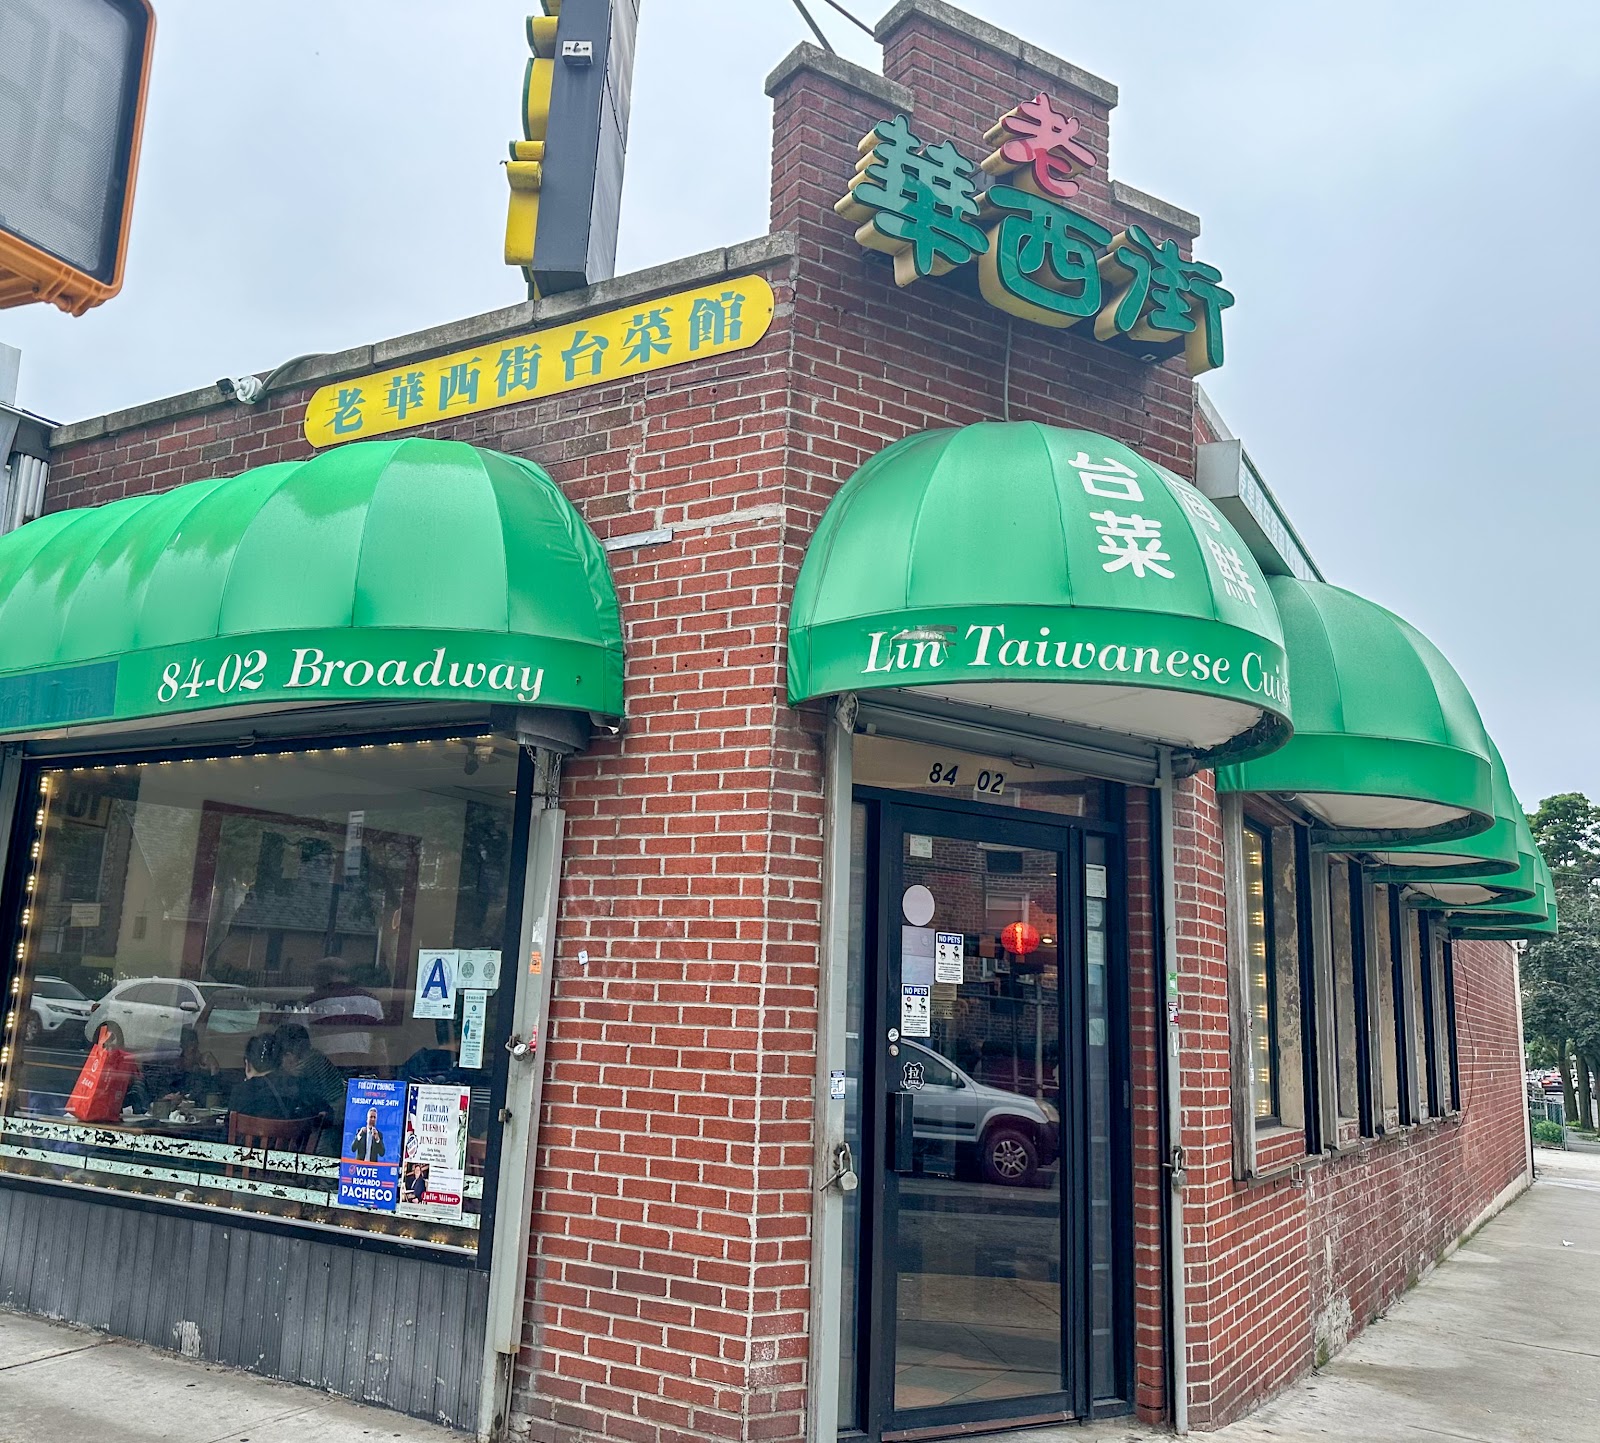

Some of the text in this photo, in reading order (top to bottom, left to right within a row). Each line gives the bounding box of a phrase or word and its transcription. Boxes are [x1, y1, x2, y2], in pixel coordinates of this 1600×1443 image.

[1001, 91, 1098, 198] 老
[846, 113, 1235, 369] 華西街
[323, 290, 747, 436] 老華西街台菜館
[1068, 451, 1176, 579] 台菜
[861, 630, 949, 675] Lin
[964, 623, 1231, 685] Taiwanese
[156, 647, 545, 704] 84-02 Broadway
[929, 762, 1005, 794] 84 02
[938, 934, 961, 944] NO PETS
[421, 958, 448, 999] A
[904, 986, 928, 995] NO PETS
[908, 1066, 920, 1079] 拉
[351, 1097, 372, 1105] TUESDAY
[385, 1099, 400, 1107] 24TH
[423, 1103, 449, 1114] PRIMARY
[422, 1113, 449, 1123] ELECTION
[419, 1136, 434, 1145] JUNE
[356, 1166, 378, 1178] VOTE
[352, 1177, 381, 1187] RICARDO
[341, 1185, 393, 1202] PACHECO
